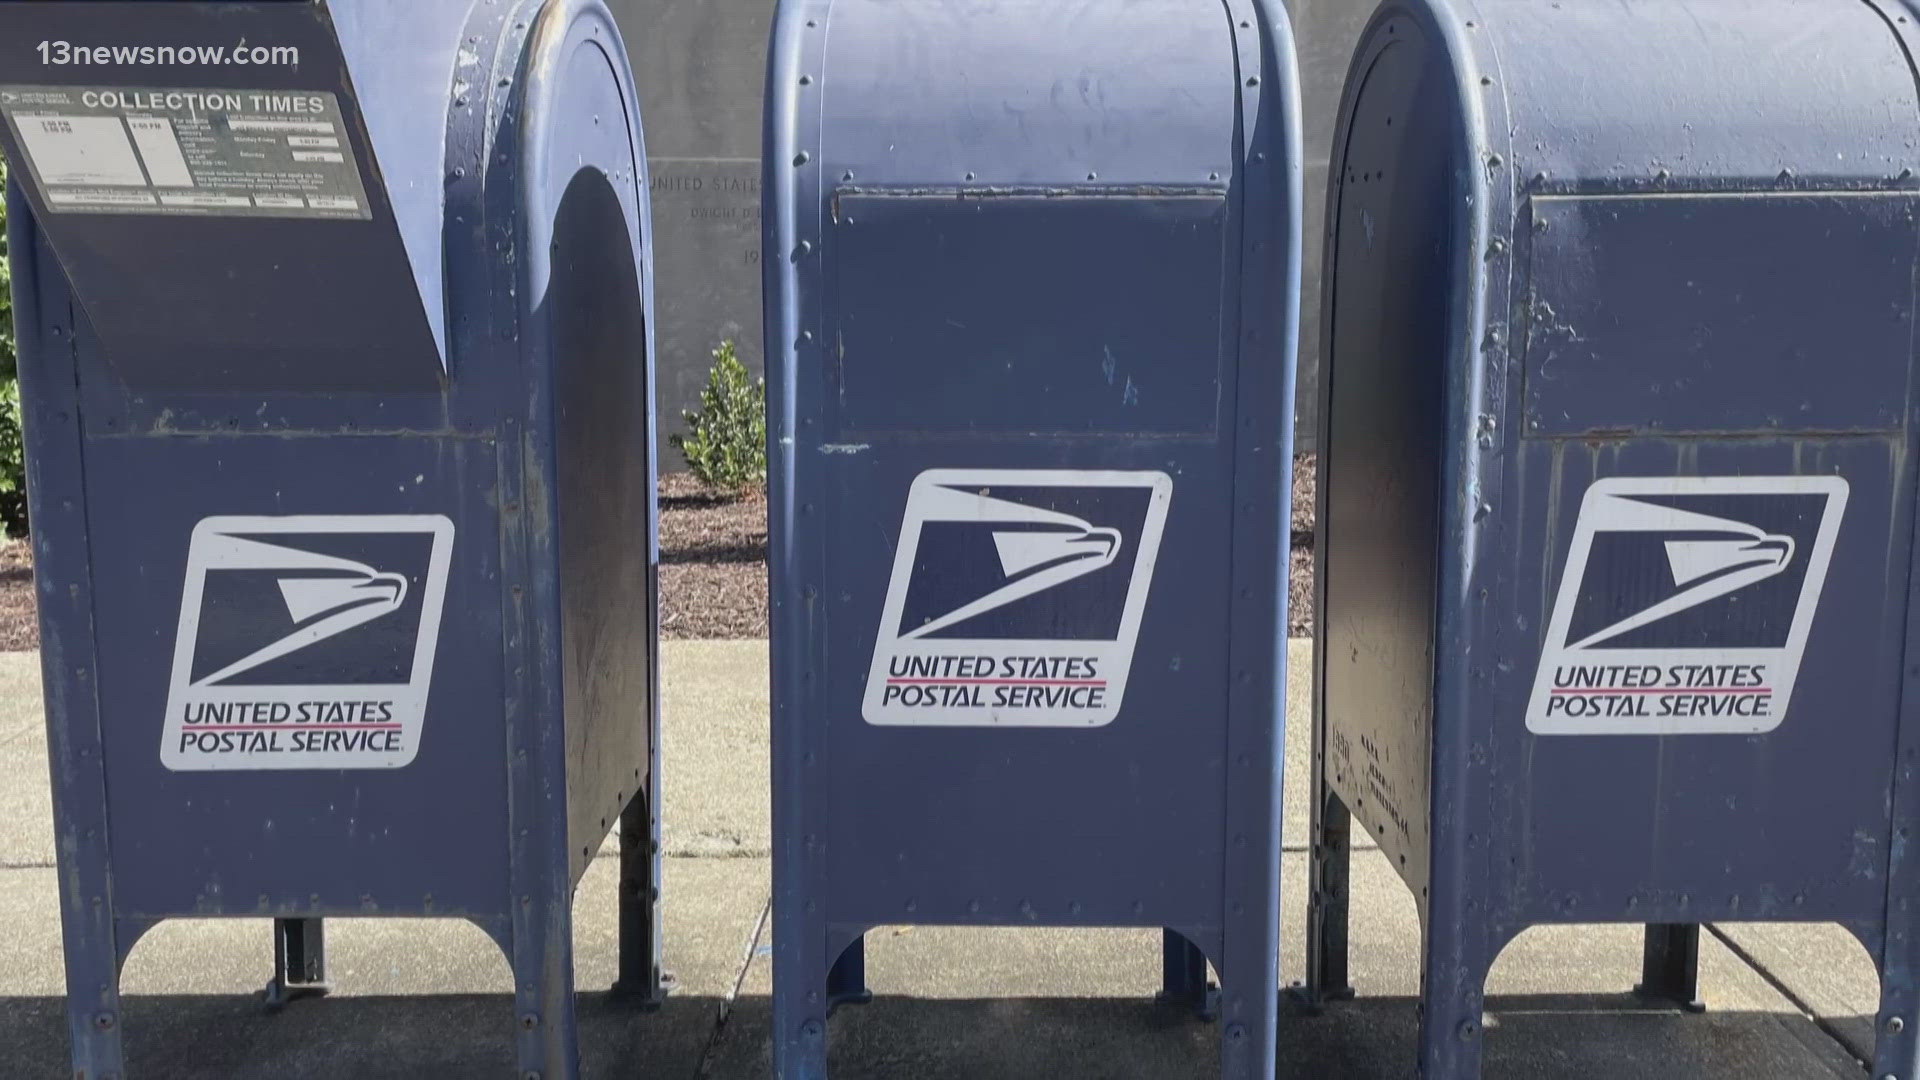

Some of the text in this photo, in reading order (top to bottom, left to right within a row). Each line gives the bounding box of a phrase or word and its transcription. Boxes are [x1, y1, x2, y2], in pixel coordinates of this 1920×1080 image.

[81, 90, 324, 114] COLLECTION TIMES
[713, 176, 761, 192] STATE
[889, 655, 1099, 679] UNITED STATES
[1554, 665, 1766, 688] UNITED STATES
[881, 685, 986, 707] POSTAL
[1546, 695, 1650, 718] POSTAL
[184, 701, 394, 724] UNITED STATES
[179, 731, 284, 753] POSTAL
